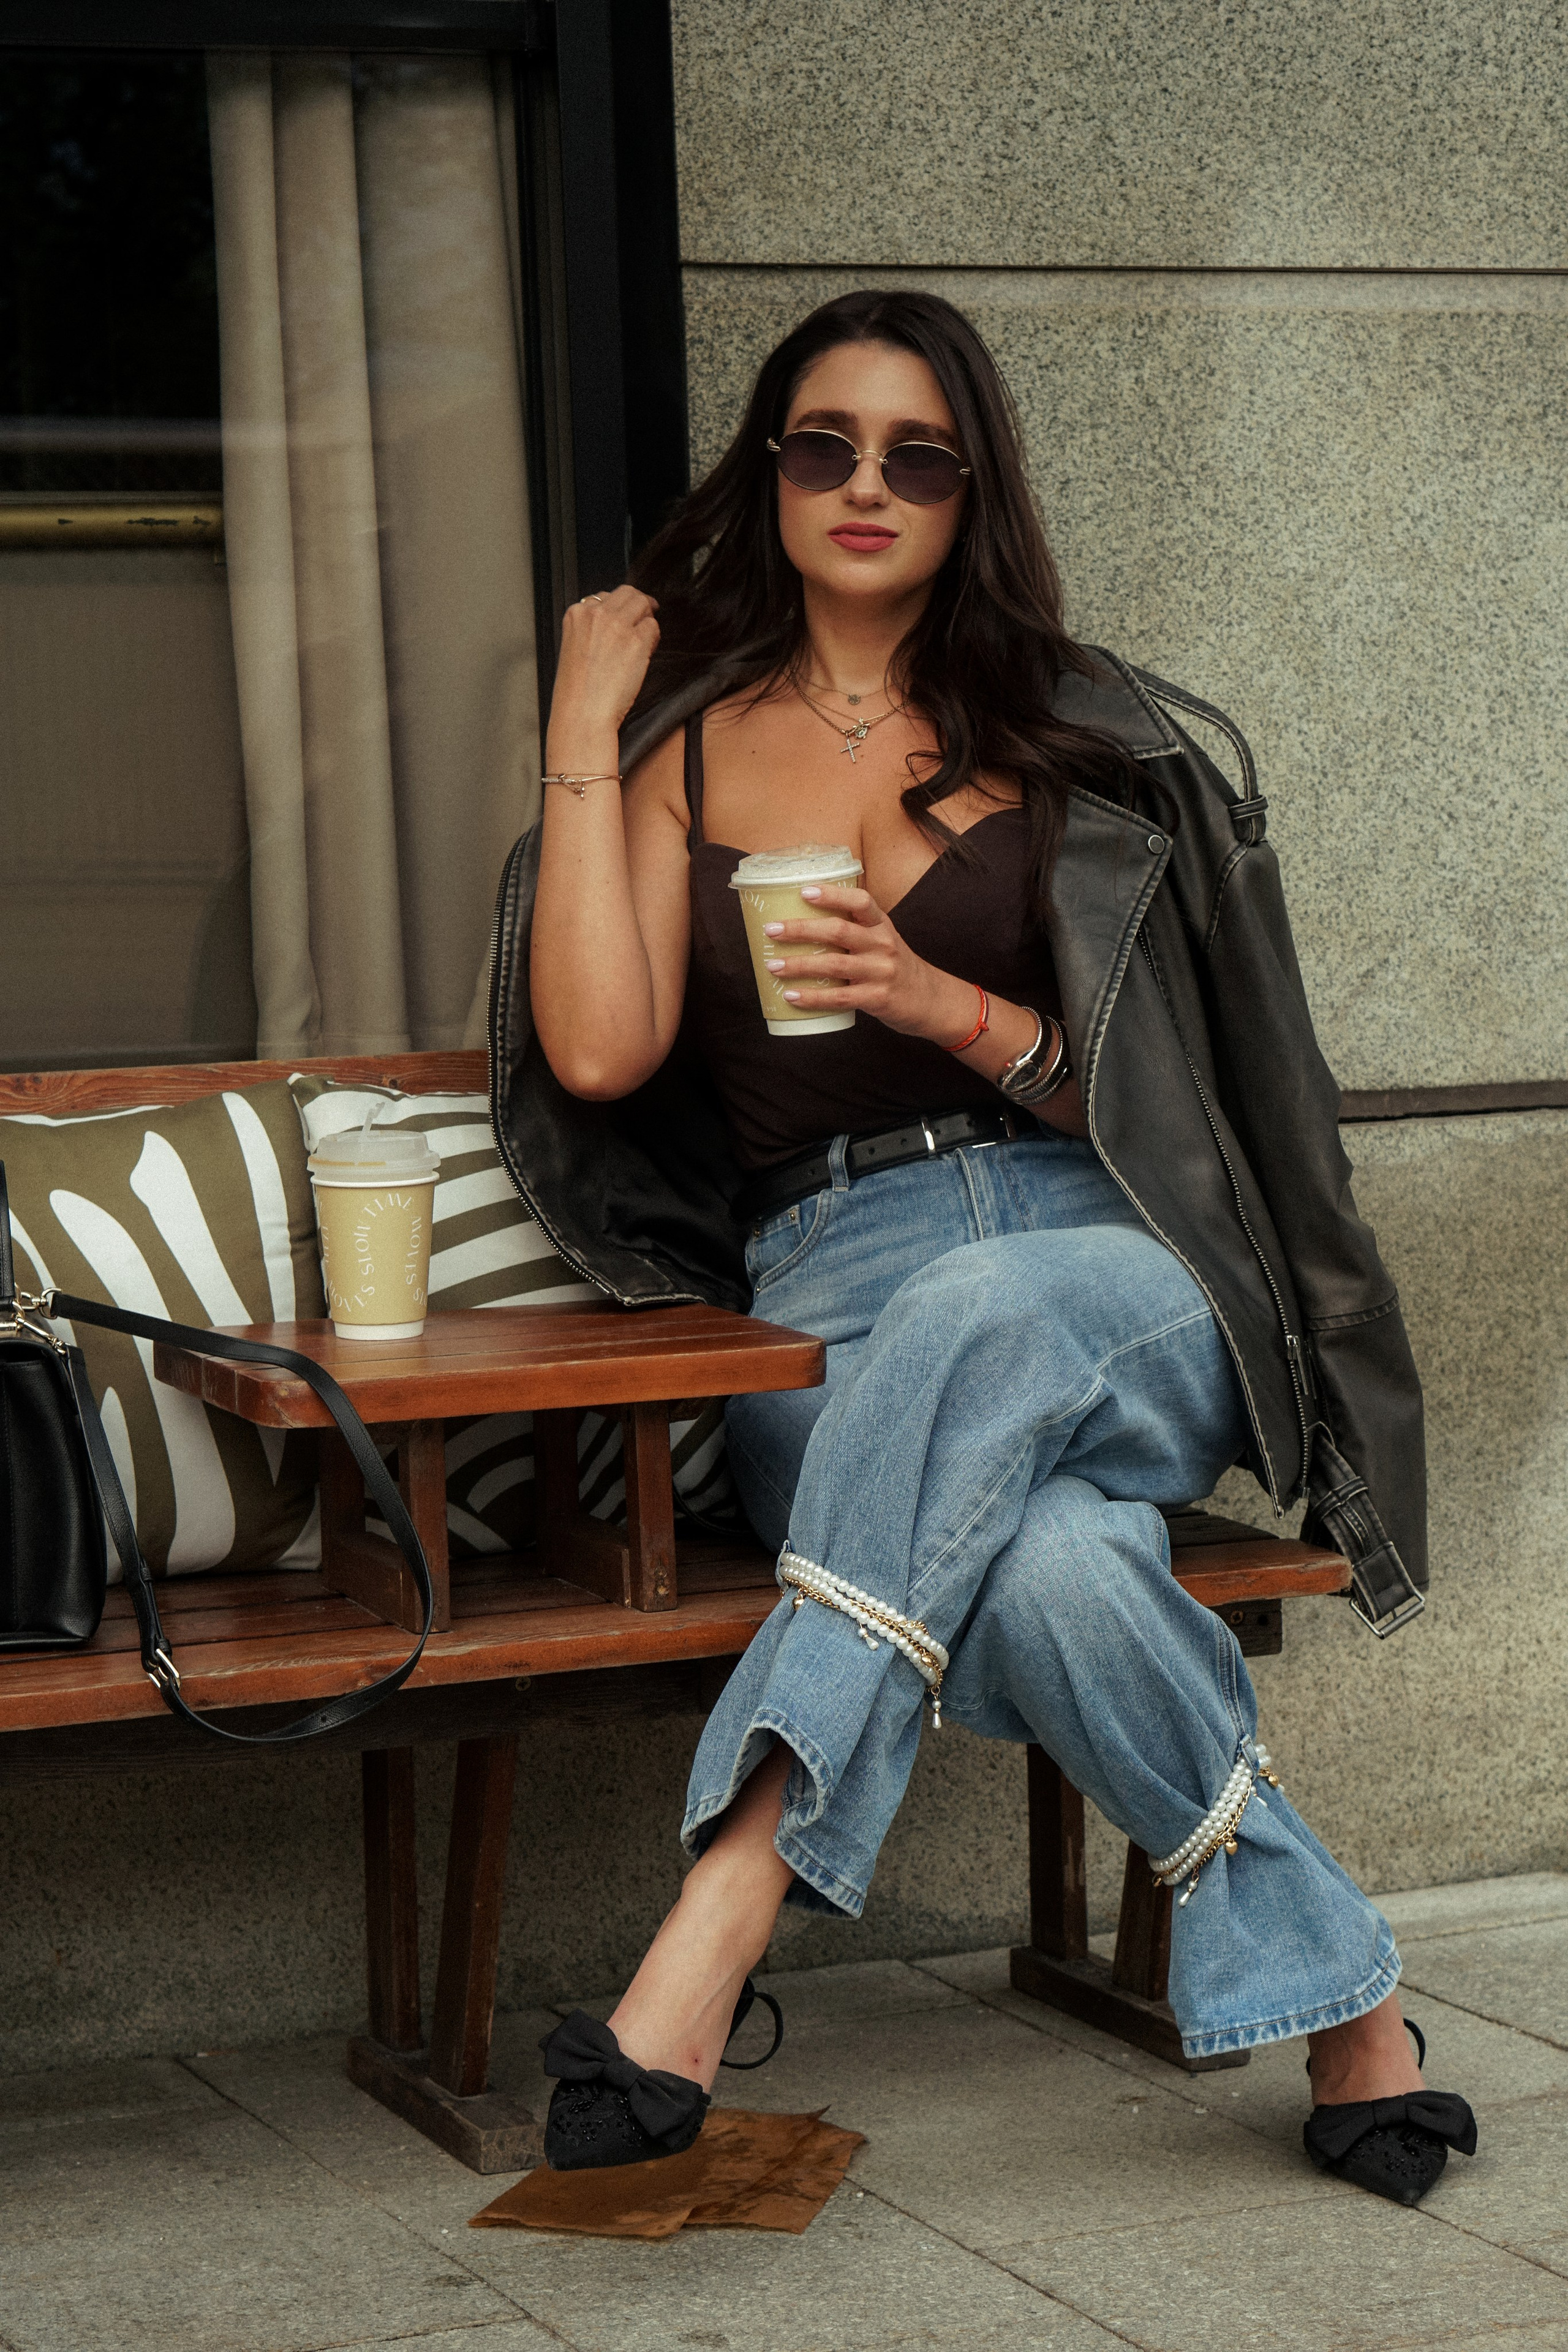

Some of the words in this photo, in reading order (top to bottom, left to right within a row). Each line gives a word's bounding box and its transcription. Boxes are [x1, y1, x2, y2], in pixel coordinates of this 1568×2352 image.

[361, 1193, 414, 1218] TIME
[353, 1219, 375, 1276] SLOW
[405, 1215, 422, 1285] MOVES
